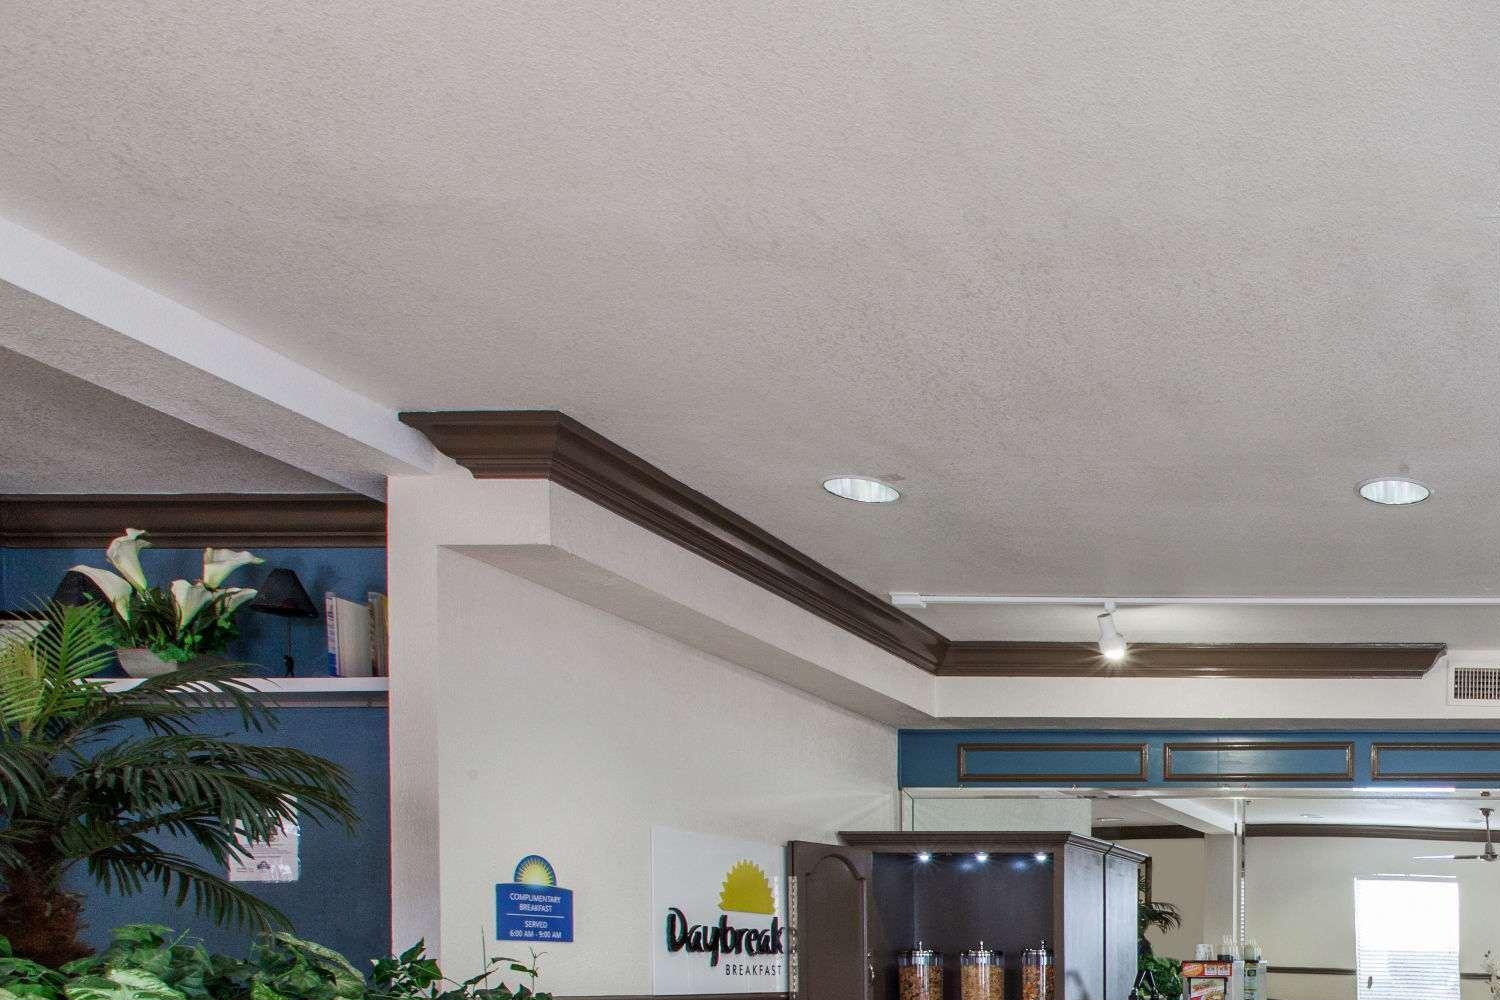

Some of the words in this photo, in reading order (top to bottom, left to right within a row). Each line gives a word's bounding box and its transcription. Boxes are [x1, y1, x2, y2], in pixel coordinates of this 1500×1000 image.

[509, 892, 562, 904] COMPLIMENTARY
[519, 903, 553, 913] BREAKFAST
[524, 920, 548, 929] SERVED
[524, 930, 535, 938] AM
[552, 931, 562, 939] AM
[666, 907, 785, 967] Daybreak
[725, 964, 782, 976] BREAKFAST
